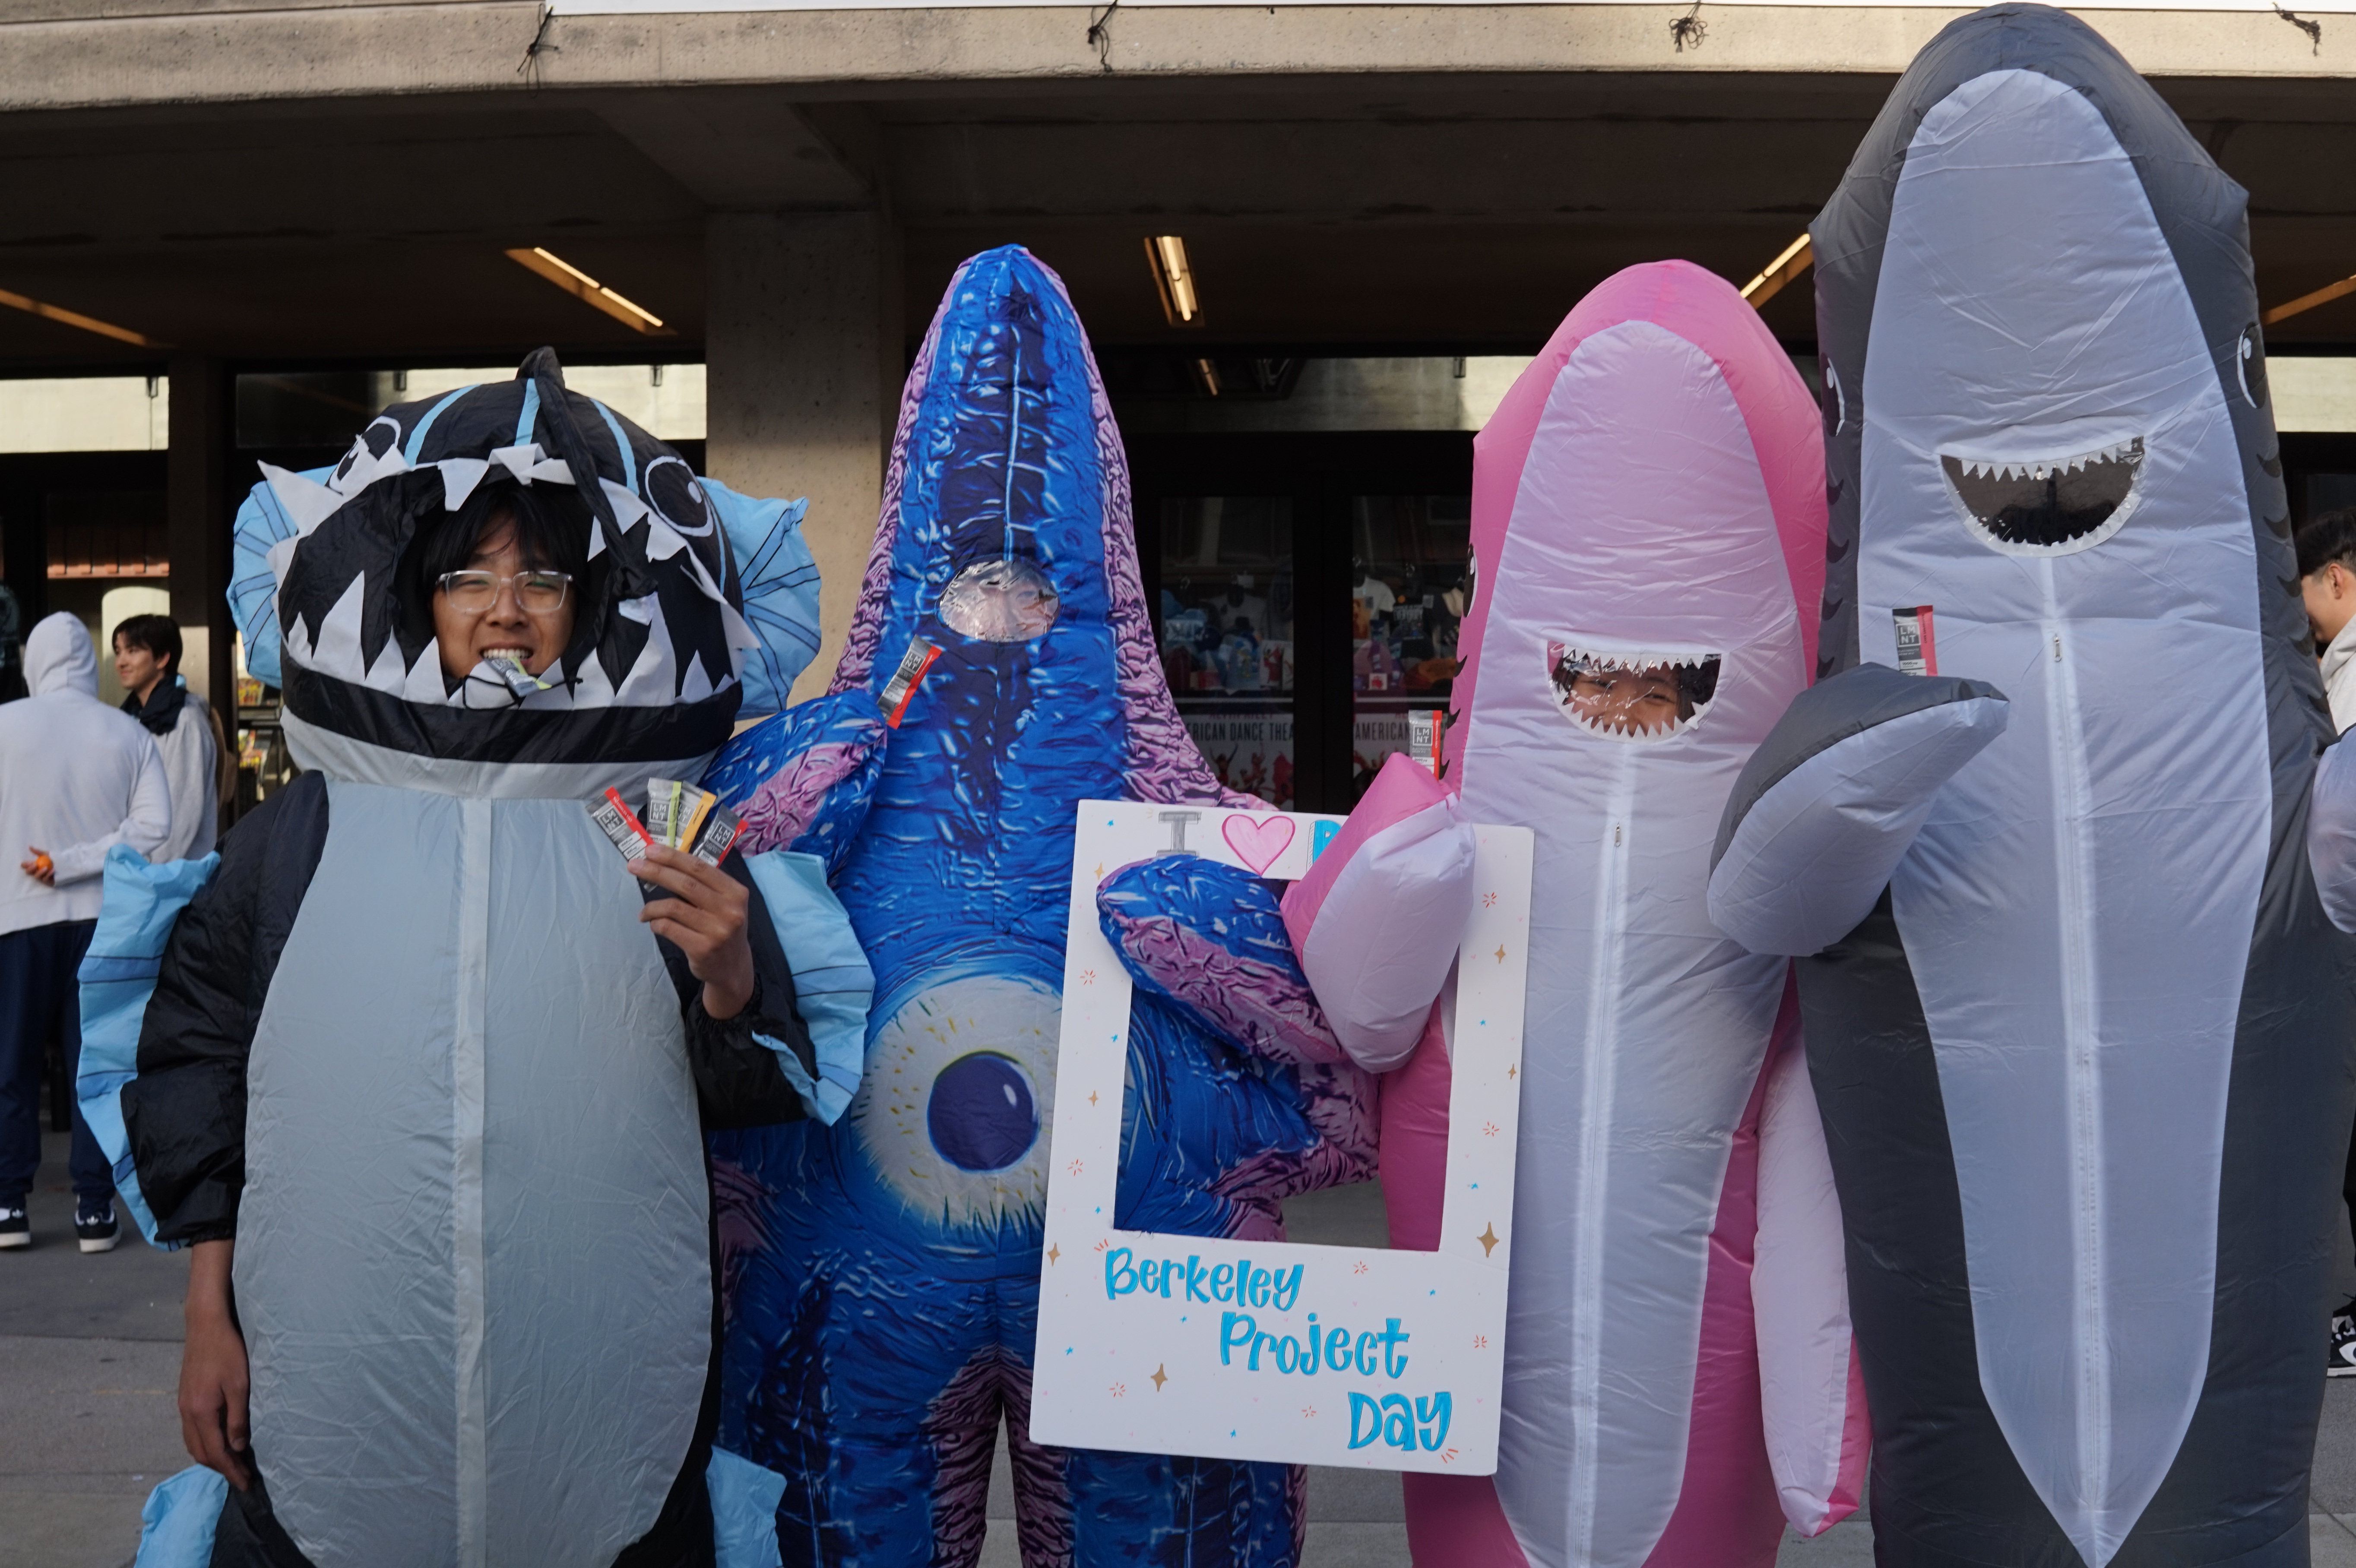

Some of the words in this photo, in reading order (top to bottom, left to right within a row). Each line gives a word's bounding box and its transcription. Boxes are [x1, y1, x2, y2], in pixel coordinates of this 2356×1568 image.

[1900, 626, 1916, 635] LM
[1901, 635, 1916, 644] NT
[905, 659, 918, 670] NT
[909, 653, 922, 664] LM
[1230, 722, 1264, 741] DANCE
[1355, 722, 1409, 740] AMERICAN
[1416, 727, 1429, 736] LM
[1416, 735, 1429, 743] NT
[653, 803, 666, 812] LM
[652, 812, 665, 820] NT
[719, 825, 731, 839] LM
[1156, 811, 1201, 857] I
[714, 832, 727, 845] NT
[1105, 1247, 1304, 1311] Berkeley
[1220, 1312, 1409, 1379] Project
[1347, 1391, 1452, 1451] Day
